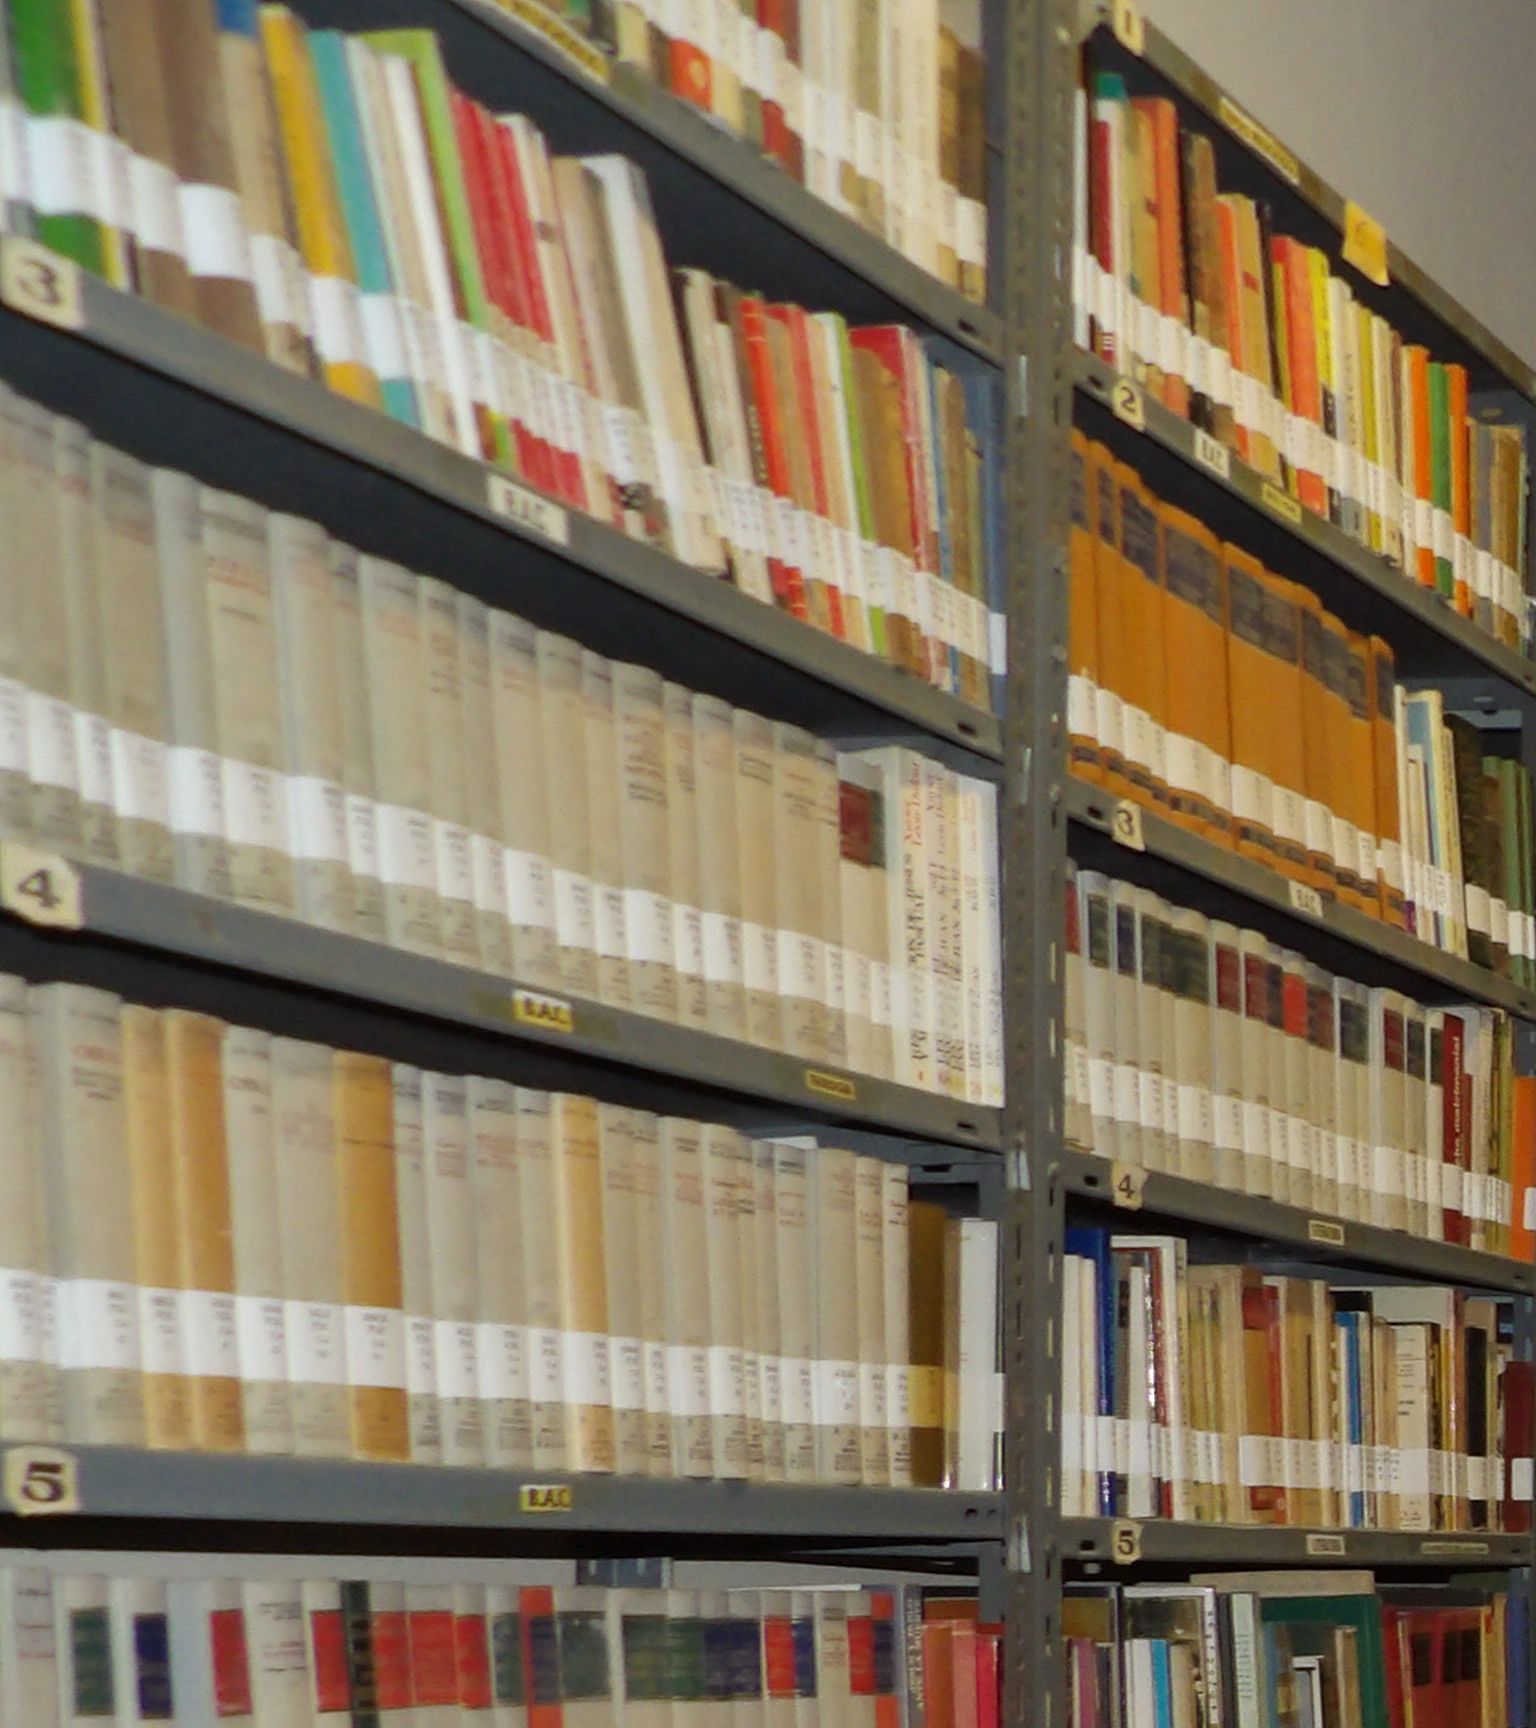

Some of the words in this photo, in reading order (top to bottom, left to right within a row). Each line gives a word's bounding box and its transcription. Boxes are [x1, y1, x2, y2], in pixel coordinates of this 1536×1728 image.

[18, 260, 61, 306] 3
[1119, 386, 1136, 414] 2
[1117, 809, 1135, 836] 3
[17, 869, 61, 909] 4
[1118, 1173, 1136, 1200] 4
[21, 1461, 65, 1503] 5
[1117, 1529, 1136, 1556] 5
